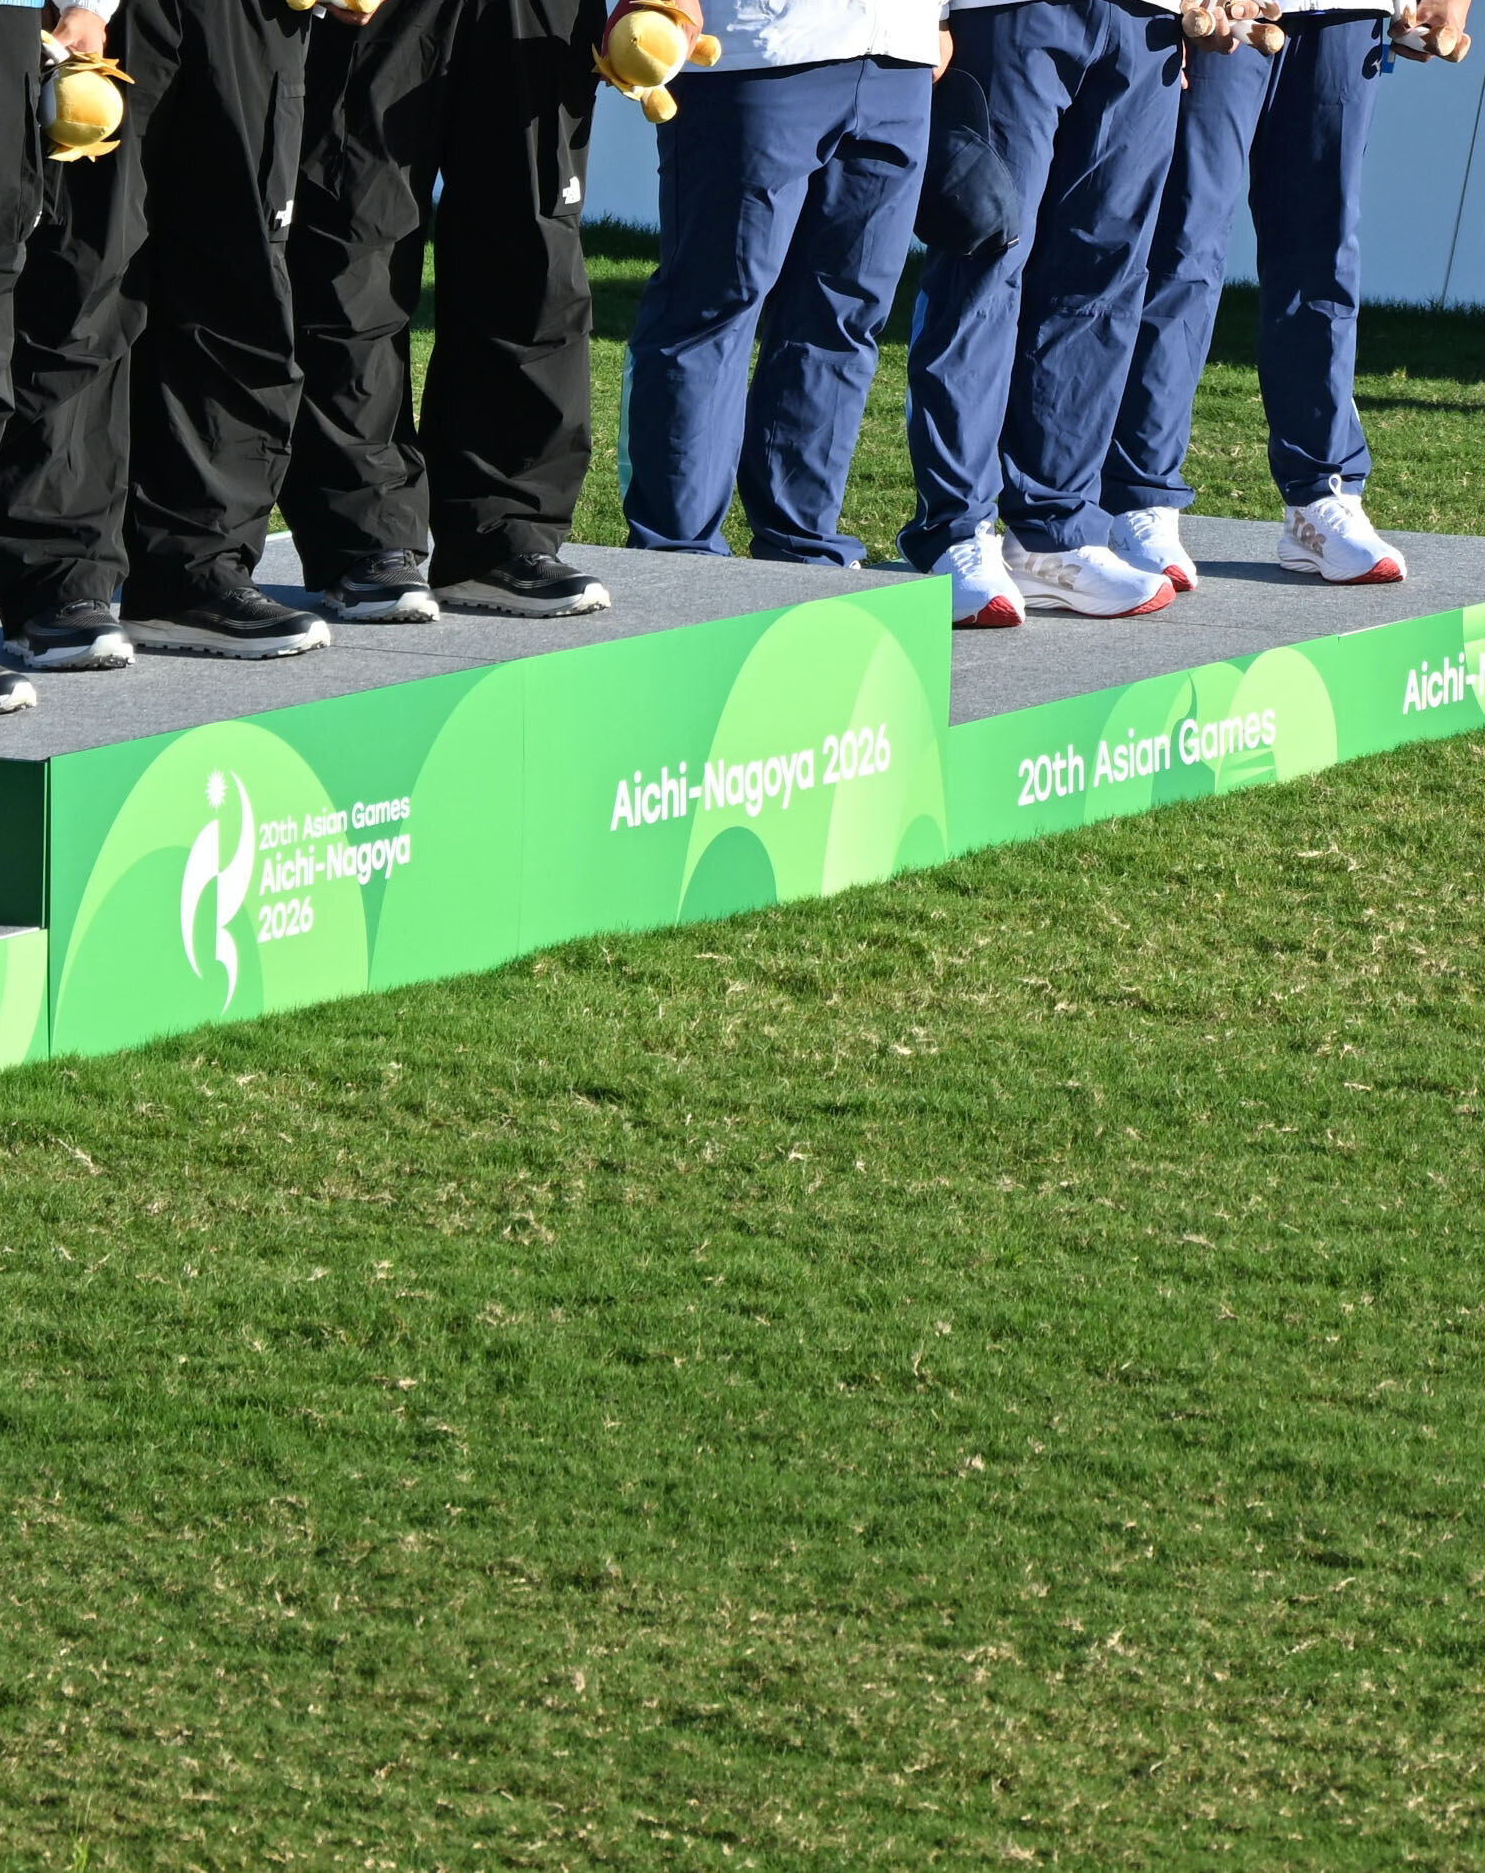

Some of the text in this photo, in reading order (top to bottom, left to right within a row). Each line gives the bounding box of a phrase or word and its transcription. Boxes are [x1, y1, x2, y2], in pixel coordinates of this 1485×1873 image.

[610, 722, 891, 832] Aichi-Nagoya 2026
[1016, 706, 1277, 807] 20th Asian Games
[258, 795, 411, 850] 20th Asian Games
[258, 832, 411, 897] Aichi-Nagoya
[257, 896, 315, 944] 2026
